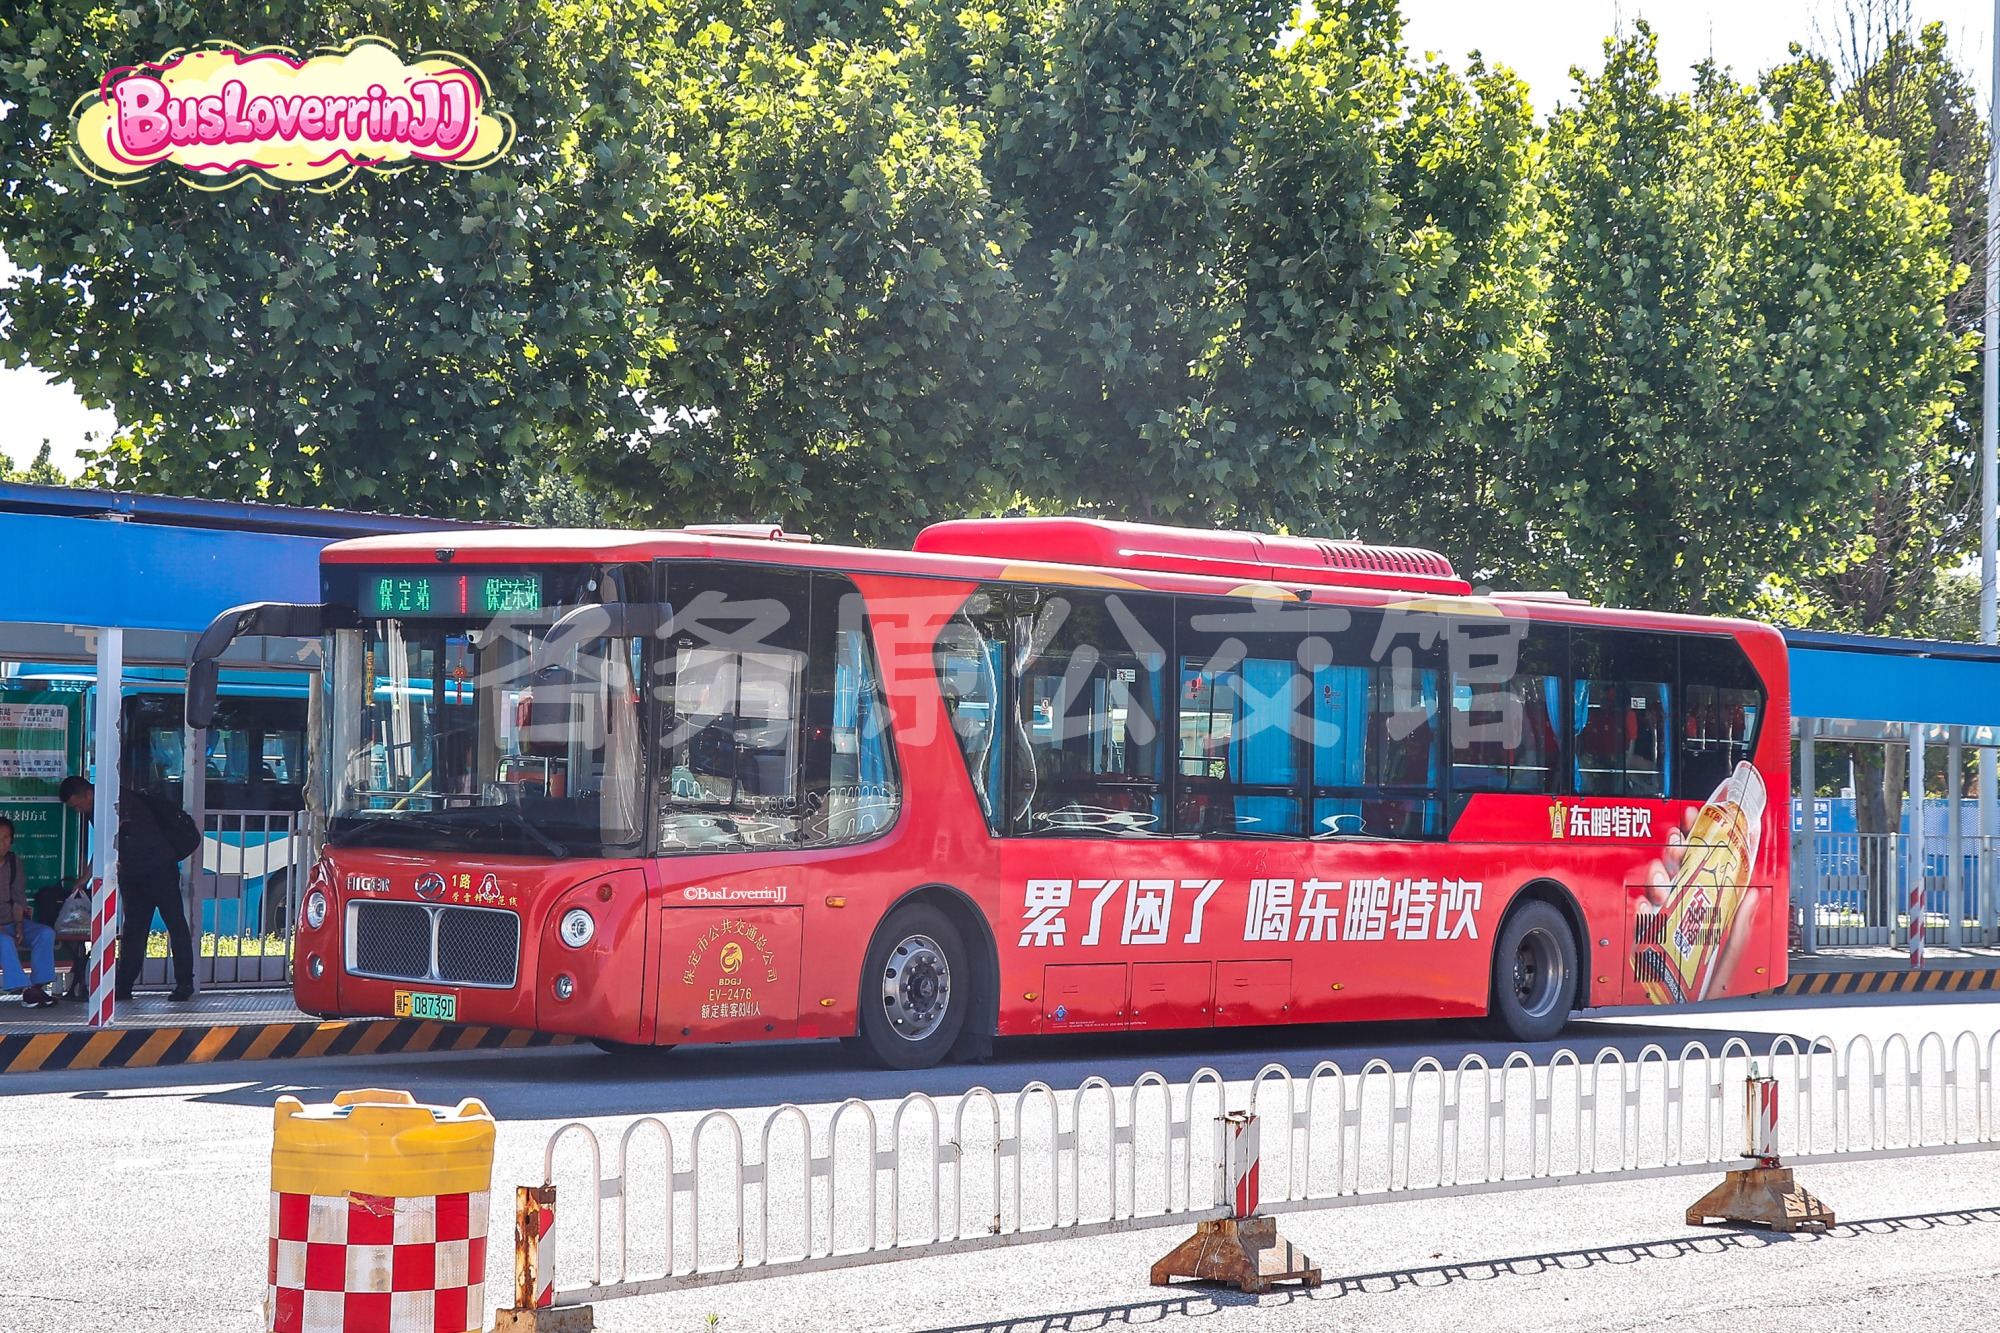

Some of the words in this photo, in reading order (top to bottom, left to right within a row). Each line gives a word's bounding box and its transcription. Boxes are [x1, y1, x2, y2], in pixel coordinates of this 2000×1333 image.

[379, 579, 430, 611] 保定站
[458, 575, 468, 614] 1
[485, 578, 538, 611] 保定东站
[1570, 804, 1652, 838] 东鹏特饮
[347, 876, 390, 892] HIGER
[451, 873, 471, 890] 1路
[1018, 878, 1225, 947] 累了困了
[1243, 876, 1484, 942] 喝东鹏特饮
[682, 918, 778, 985] 保定市公共交通总公司
[709, 988, 752, 1001] EV-2476
[718, 978, 742, 986] BDGJ
